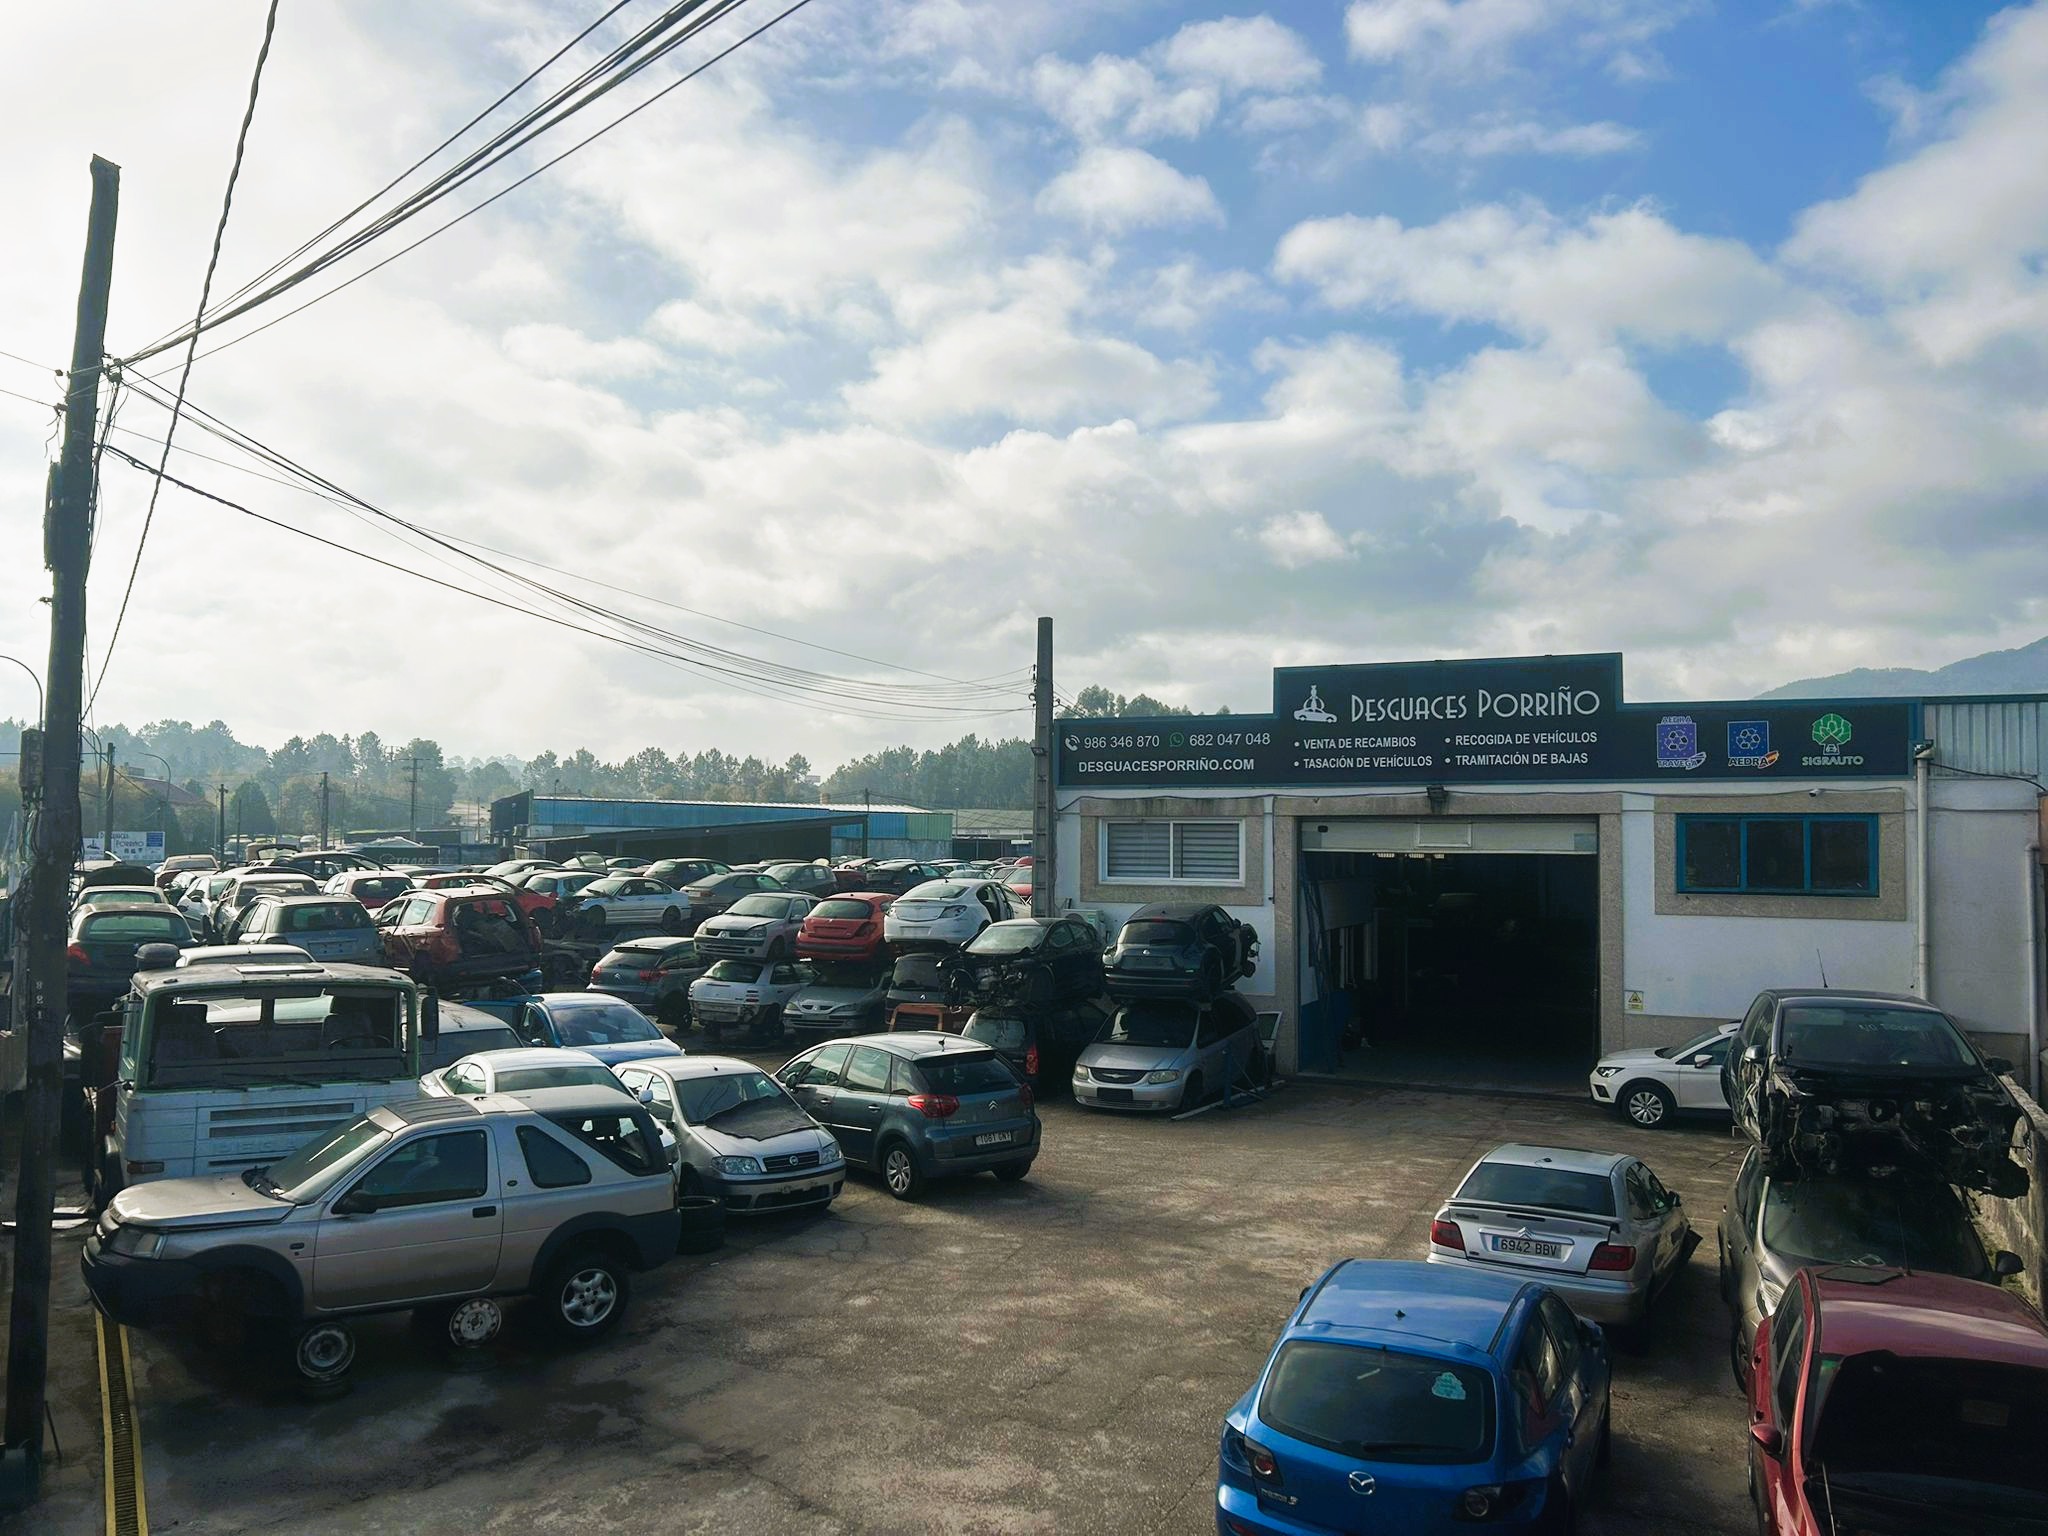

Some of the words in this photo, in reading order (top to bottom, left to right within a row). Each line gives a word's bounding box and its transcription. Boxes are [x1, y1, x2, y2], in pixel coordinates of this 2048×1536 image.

[1351, 694, 1467, 723] DESGUACES
[1478, 685, 1600, 718] PORRIÑO
[1083, 736, 1107, 749] 986
[1110, 735, 1133, 748] 346
[1136, 734, 1160, 748] 870
[1189, 733, 1214, 747] 682
[1216, 733, 1242, 746] 047
[1245, 732, 1271, 746] 048
[1303, 738, 1336, 750] VENTA
[1338, 737, 1353, 749] DE
[1354, 736, 1417, 748] RECAMBIOS
[1455, 733, 1513, 746] RECOGIDA
[1516, 733, 1531, 745] DE
[1532, 729, 1598, 744] VEHÍCULOS
[1078, 756, 1255, 773] DESGUACESPORRIÑO.COM
[1303, 754, 1354, 769] TASACIÓN
[1356, 757, 1371, 768] DE
[1372, 753, 1433, 768] VEHÍCULOS
[1454, 751, 1530, 766] TRAMITACIÓN
[1532, 753, 1548, 765] DE
[1550, 752, 1589, 765] BAJAS
[1728, 757, 1768, 767] AEDRA
[1801, 755, 1864, 766] SIGRAUTO
[1500, 1239, 1531, 1253] 6942
[1535, 1243, 1558, 1256] BBV
